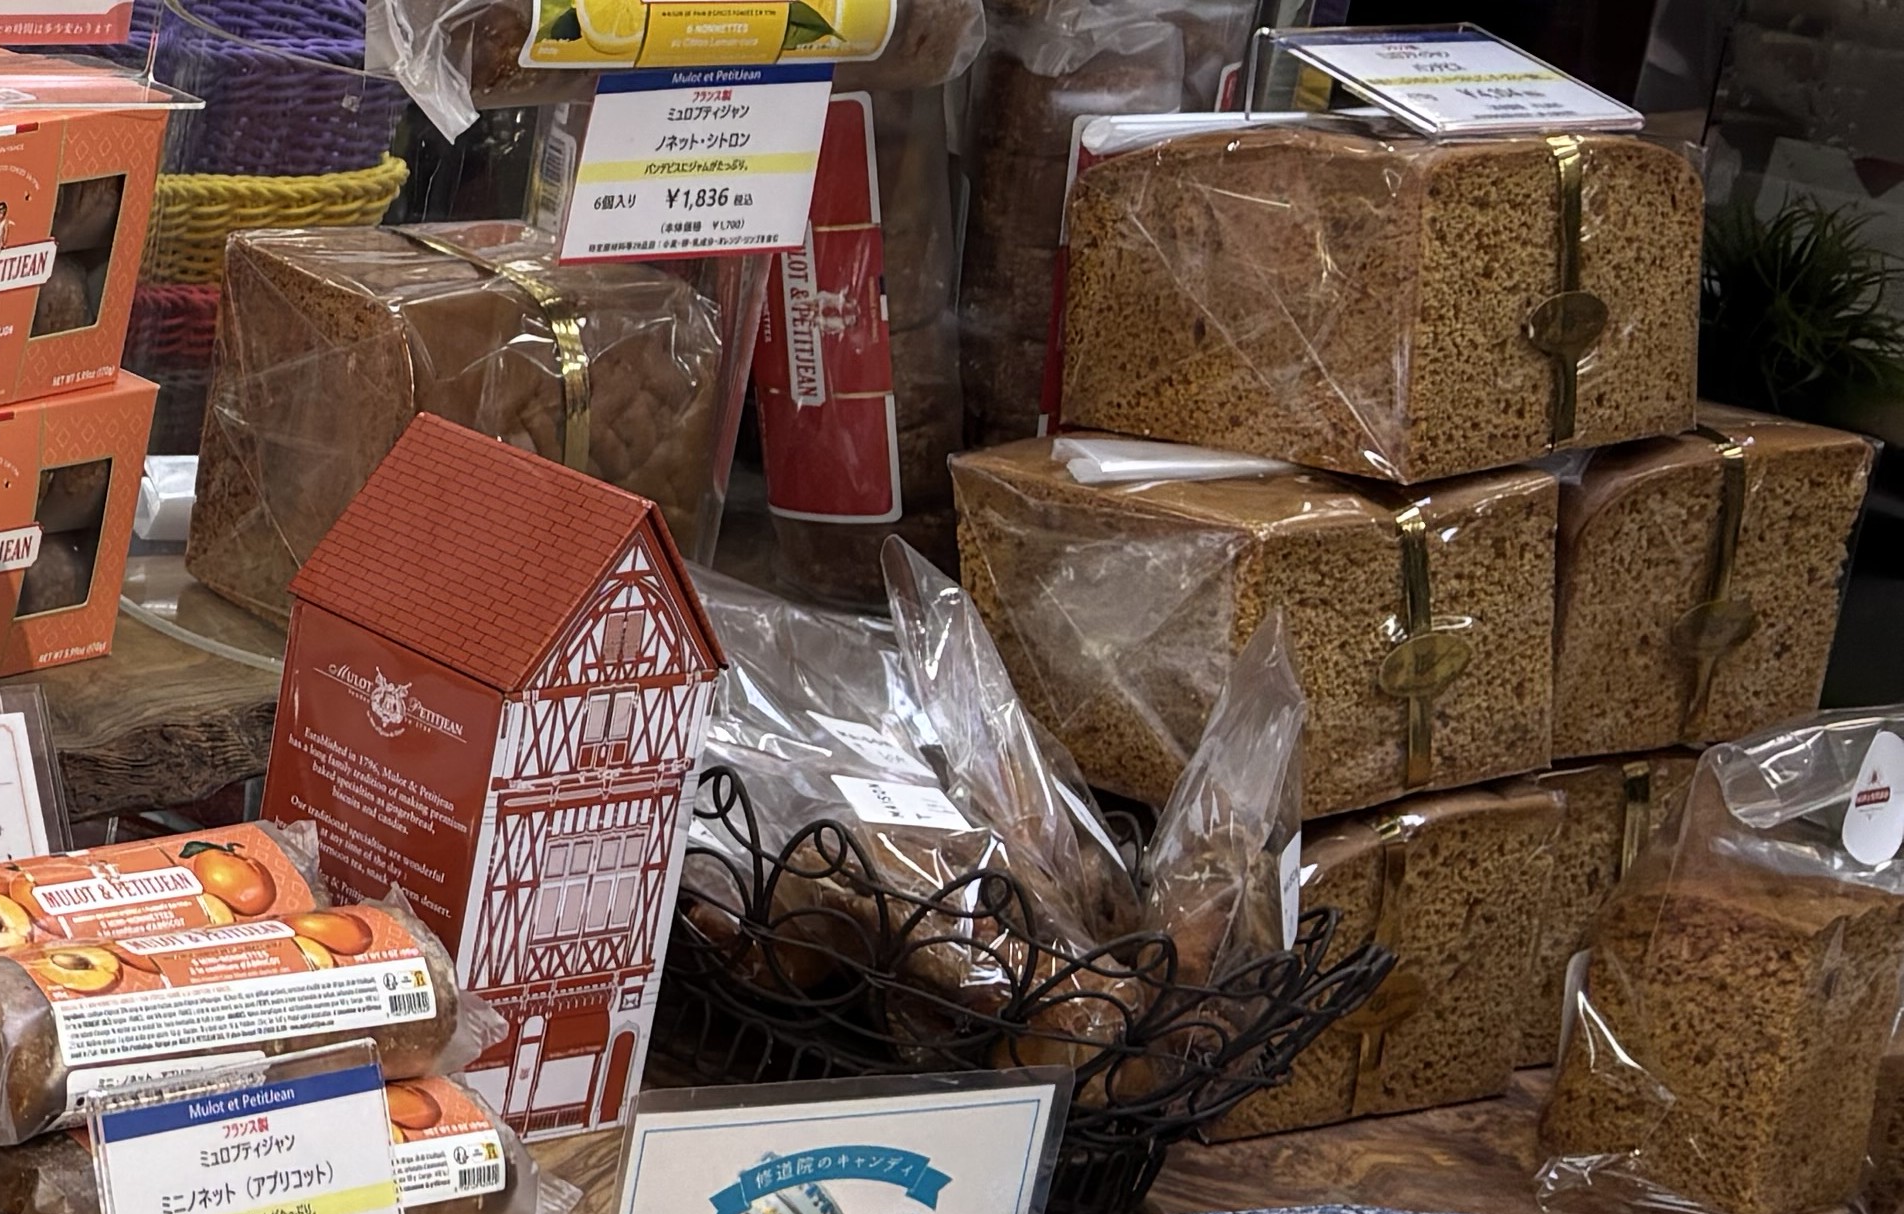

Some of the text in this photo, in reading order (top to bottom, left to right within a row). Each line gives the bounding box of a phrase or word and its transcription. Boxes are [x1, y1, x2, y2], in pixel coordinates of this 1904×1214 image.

[655, 133, 751, 152] ノネット・シトロン
[594, 194, 636, 210] 6個入り
[666, 188, 729, 210] ¥1,836
[42, 872, 191, 908] MULOT & PETITJEAN
[189, 1087, 295, 1120] Mulot et PetitJean
[223, 1117, 269, 1139] フランス製
[755, 1151, 916, 1189] 修道院のキャンディ
